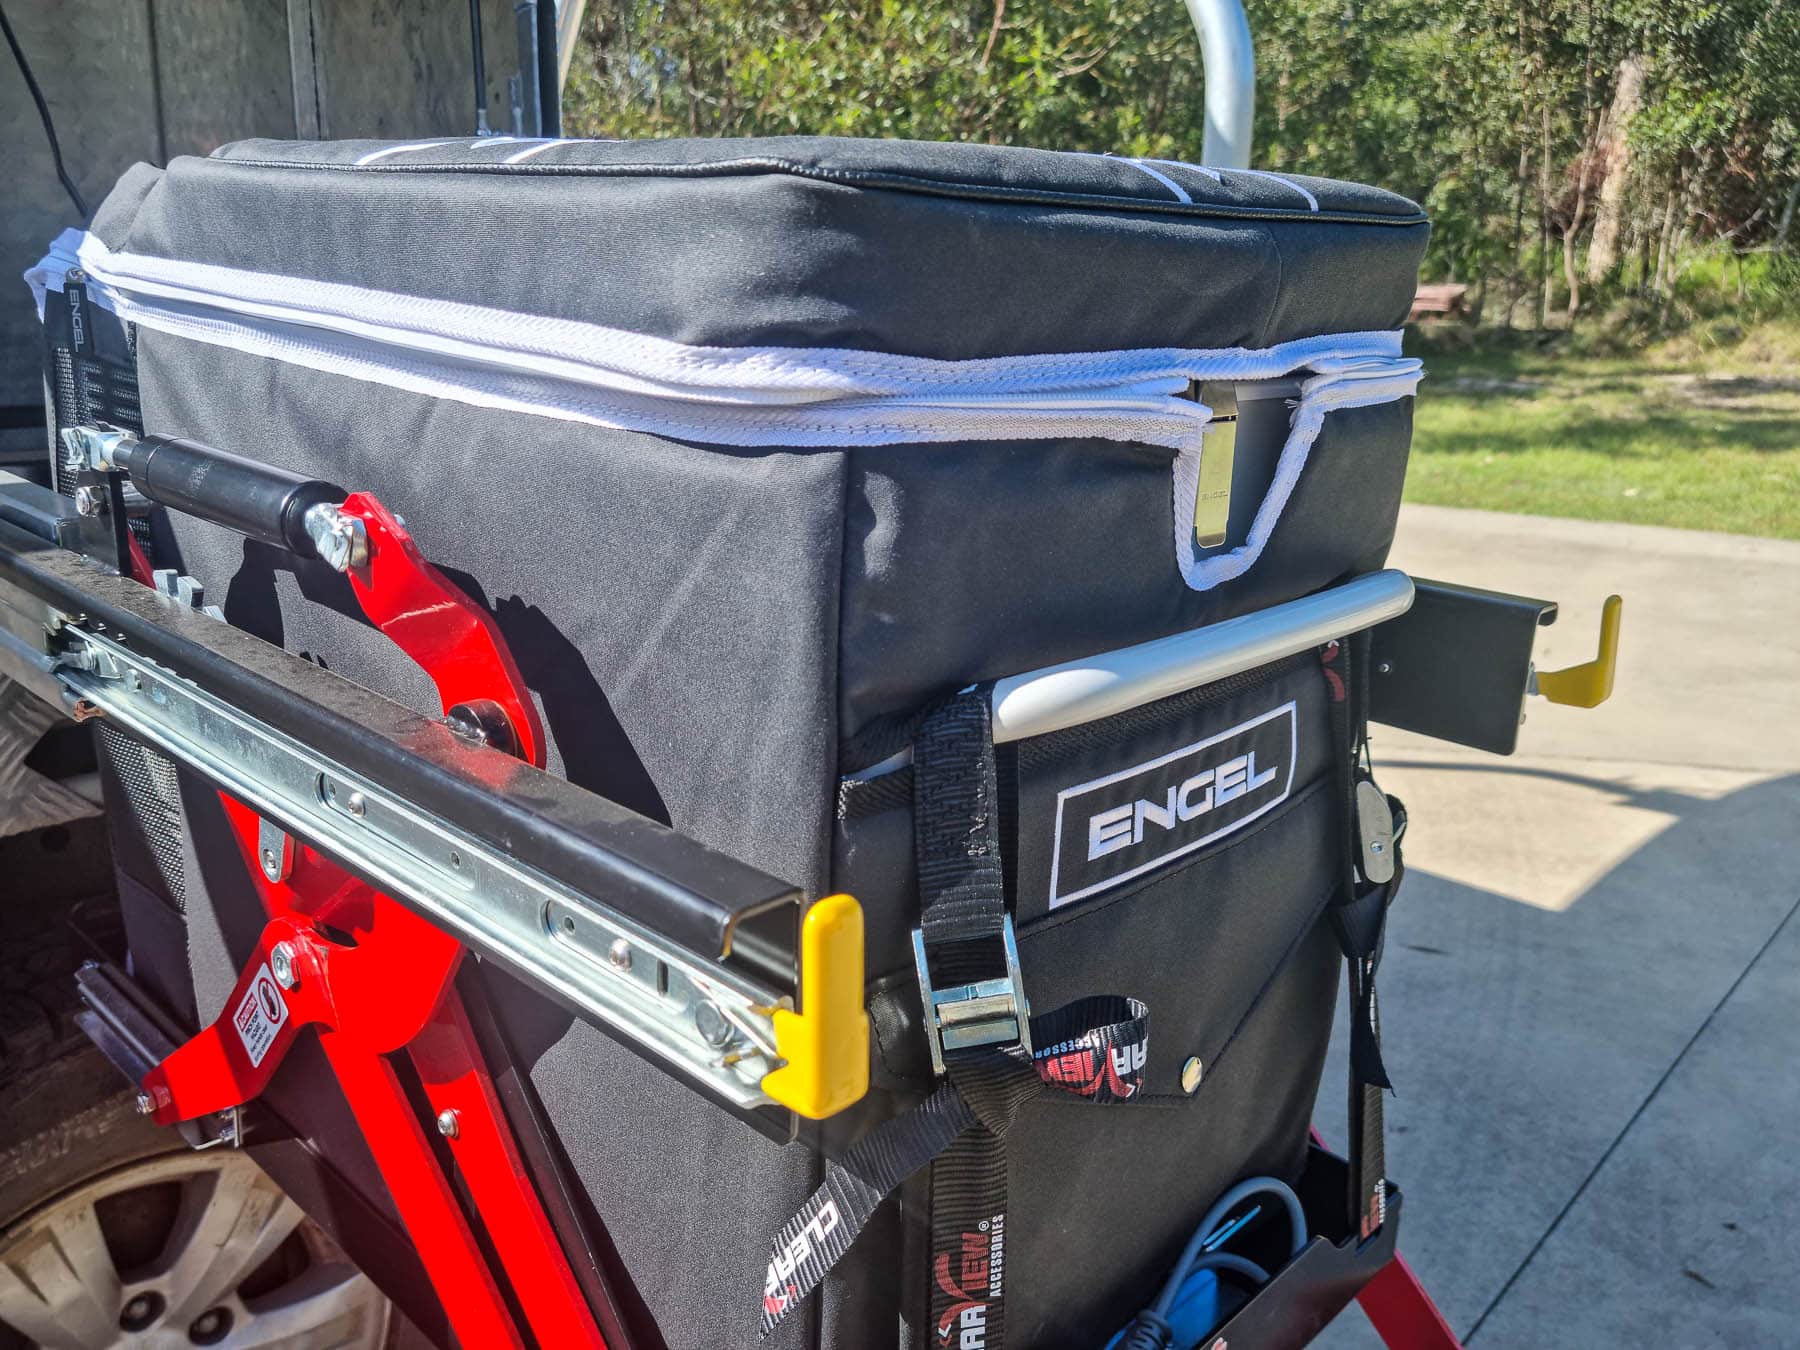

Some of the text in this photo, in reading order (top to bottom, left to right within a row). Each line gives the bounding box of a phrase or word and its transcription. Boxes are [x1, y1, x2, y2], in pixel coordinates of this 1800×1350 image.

[70, 289, 84, 352] ENGEL
[1087, 751, 1278, 861] ENGEL
[989, 1213, 1004, 1297] ACCESSORIES
